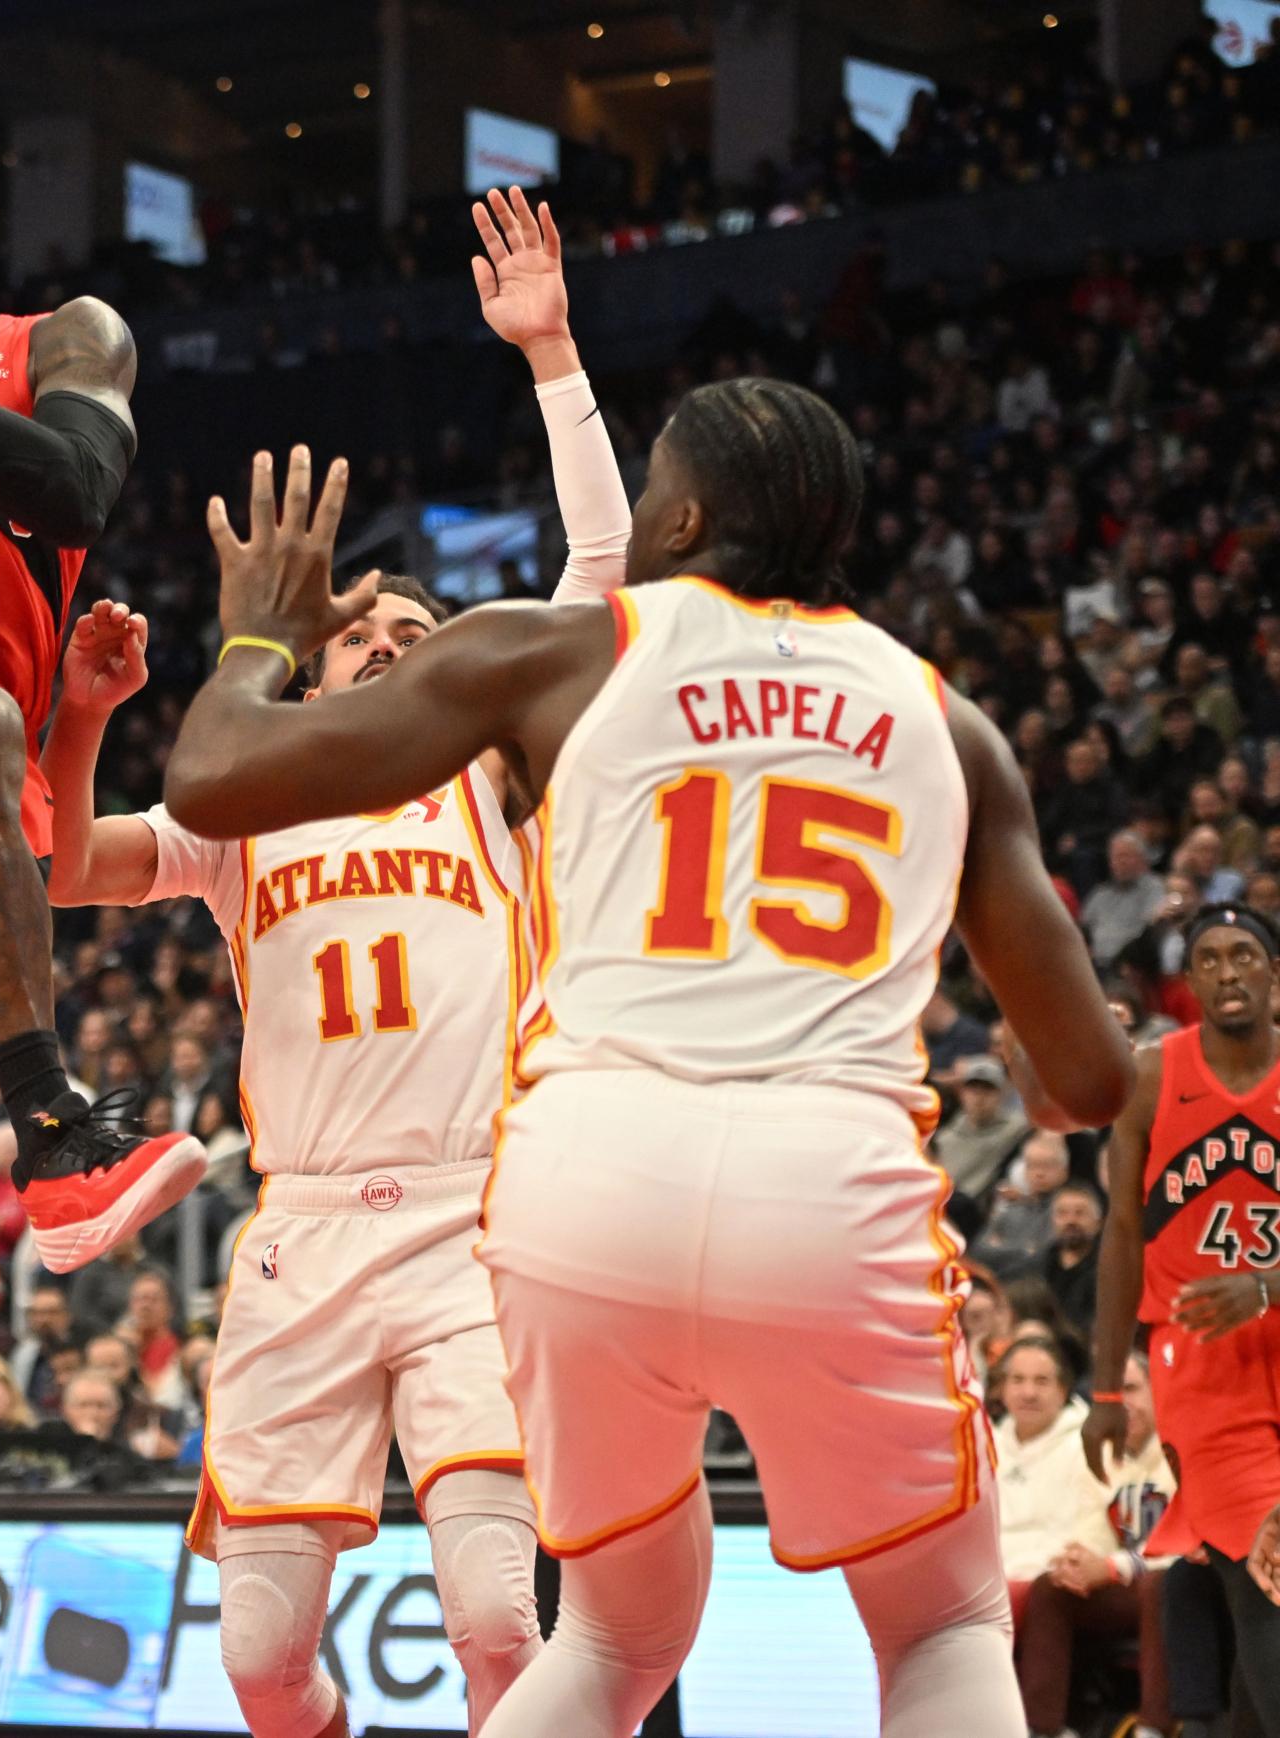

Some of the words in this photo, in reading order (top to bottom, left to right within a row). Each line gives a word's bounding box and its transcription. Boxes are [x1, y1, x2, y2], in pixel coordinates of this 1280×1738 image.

[677, 679, 894, 771] CAPELA
[402, 810, 420, 820] the
[253, 847, 485, 944] ATLANTA
[643, 766, 903, 981] 15
[312, 931, 418, 1043] 11
[361, 1186, 403, 1201] HAWKS
[1197, 1202, 1280, 1268] 43
